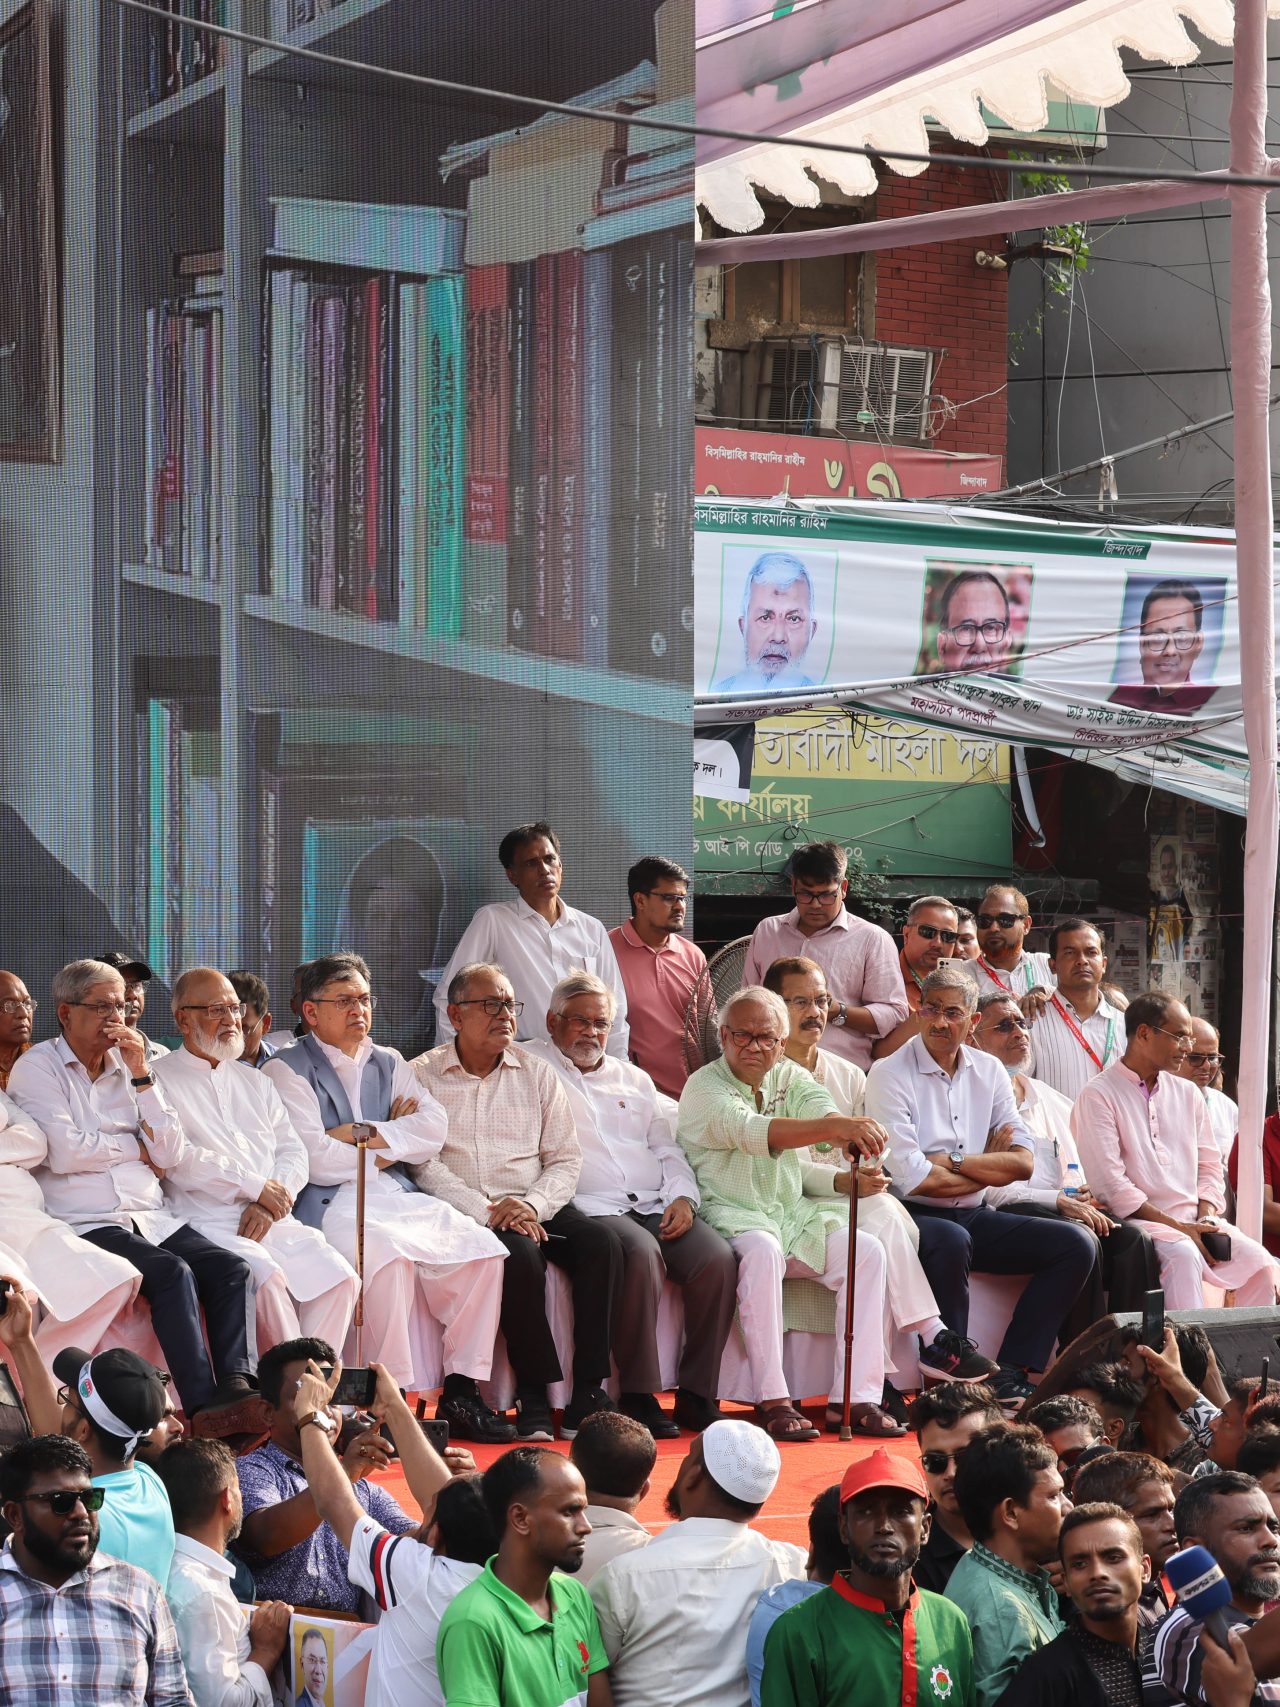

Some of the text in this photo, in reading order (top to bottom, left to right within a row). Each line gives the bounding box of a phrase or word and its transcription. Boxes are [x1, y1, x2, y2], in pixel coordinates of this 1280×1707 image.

[751, 509, 797, 528] রাহমানির
[800, 512, 829, 531] রাহিম
[1102, 539, 1146, 556] জিন্দাবাদ
[911, 696, 954, 717] মহাসচিব
[1022, 698, 1043, 714] খান
[754, 717, 853, 773] তাবাদী
[951, 733, 1000, 778] দল
[716, 781, 812, 824] কার্যালয়
[704, 835, 731, 857] আই
[736, 836, 750, 857] পি
